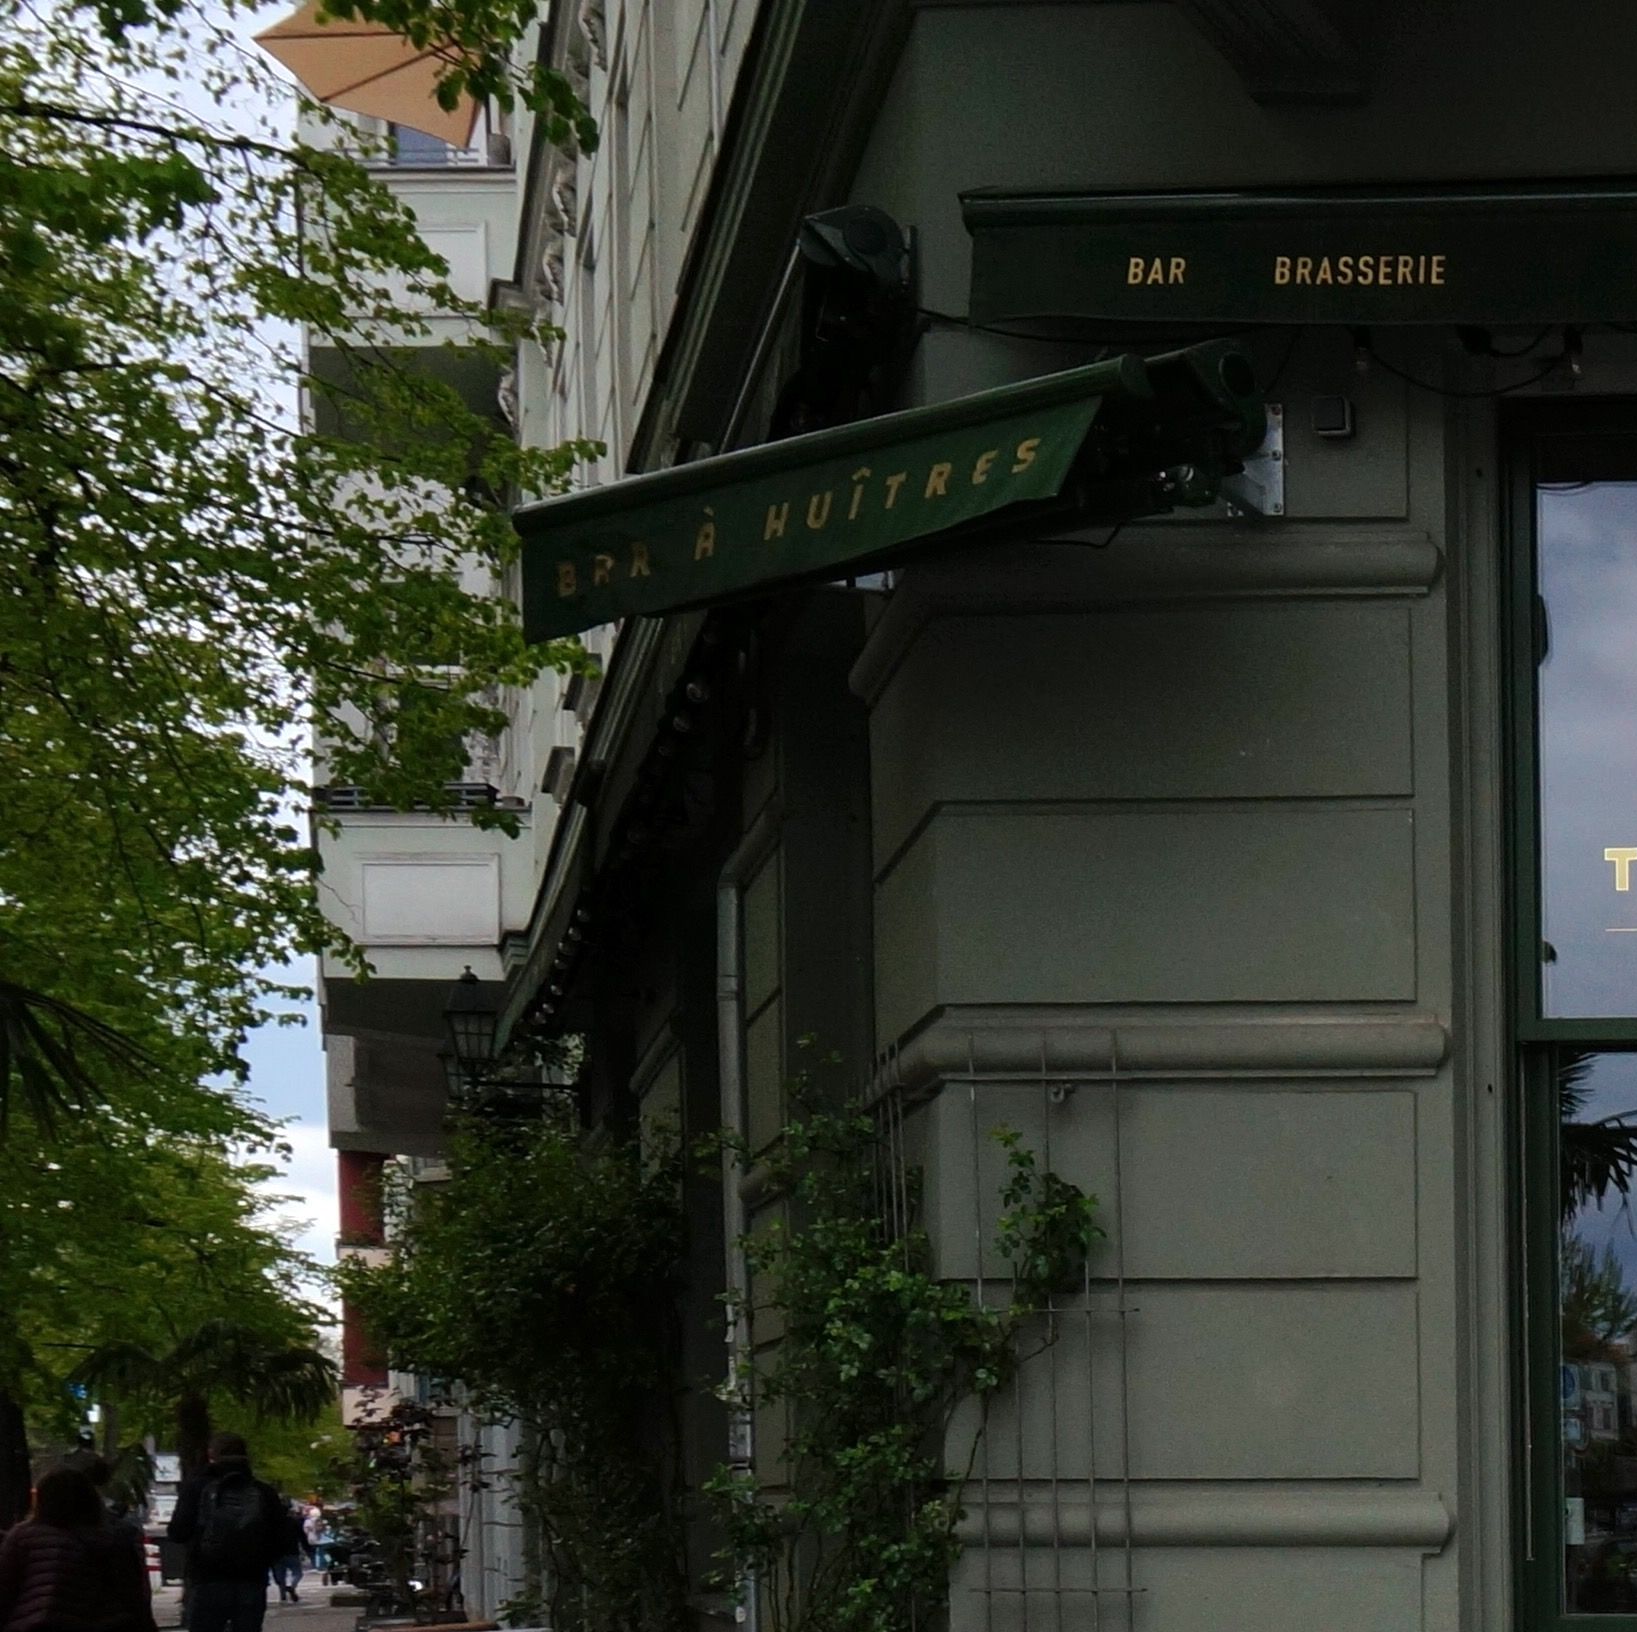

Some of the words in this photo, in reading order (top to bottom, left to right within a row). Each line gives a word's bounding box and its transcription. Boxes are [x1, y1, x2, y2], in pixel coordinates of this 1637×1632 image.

[1127, 256, 1187, 287] BAR
[1273, 254, 1447, 287] BRASSERIE
[763, 436, 1042, 542] HUÎTRES
